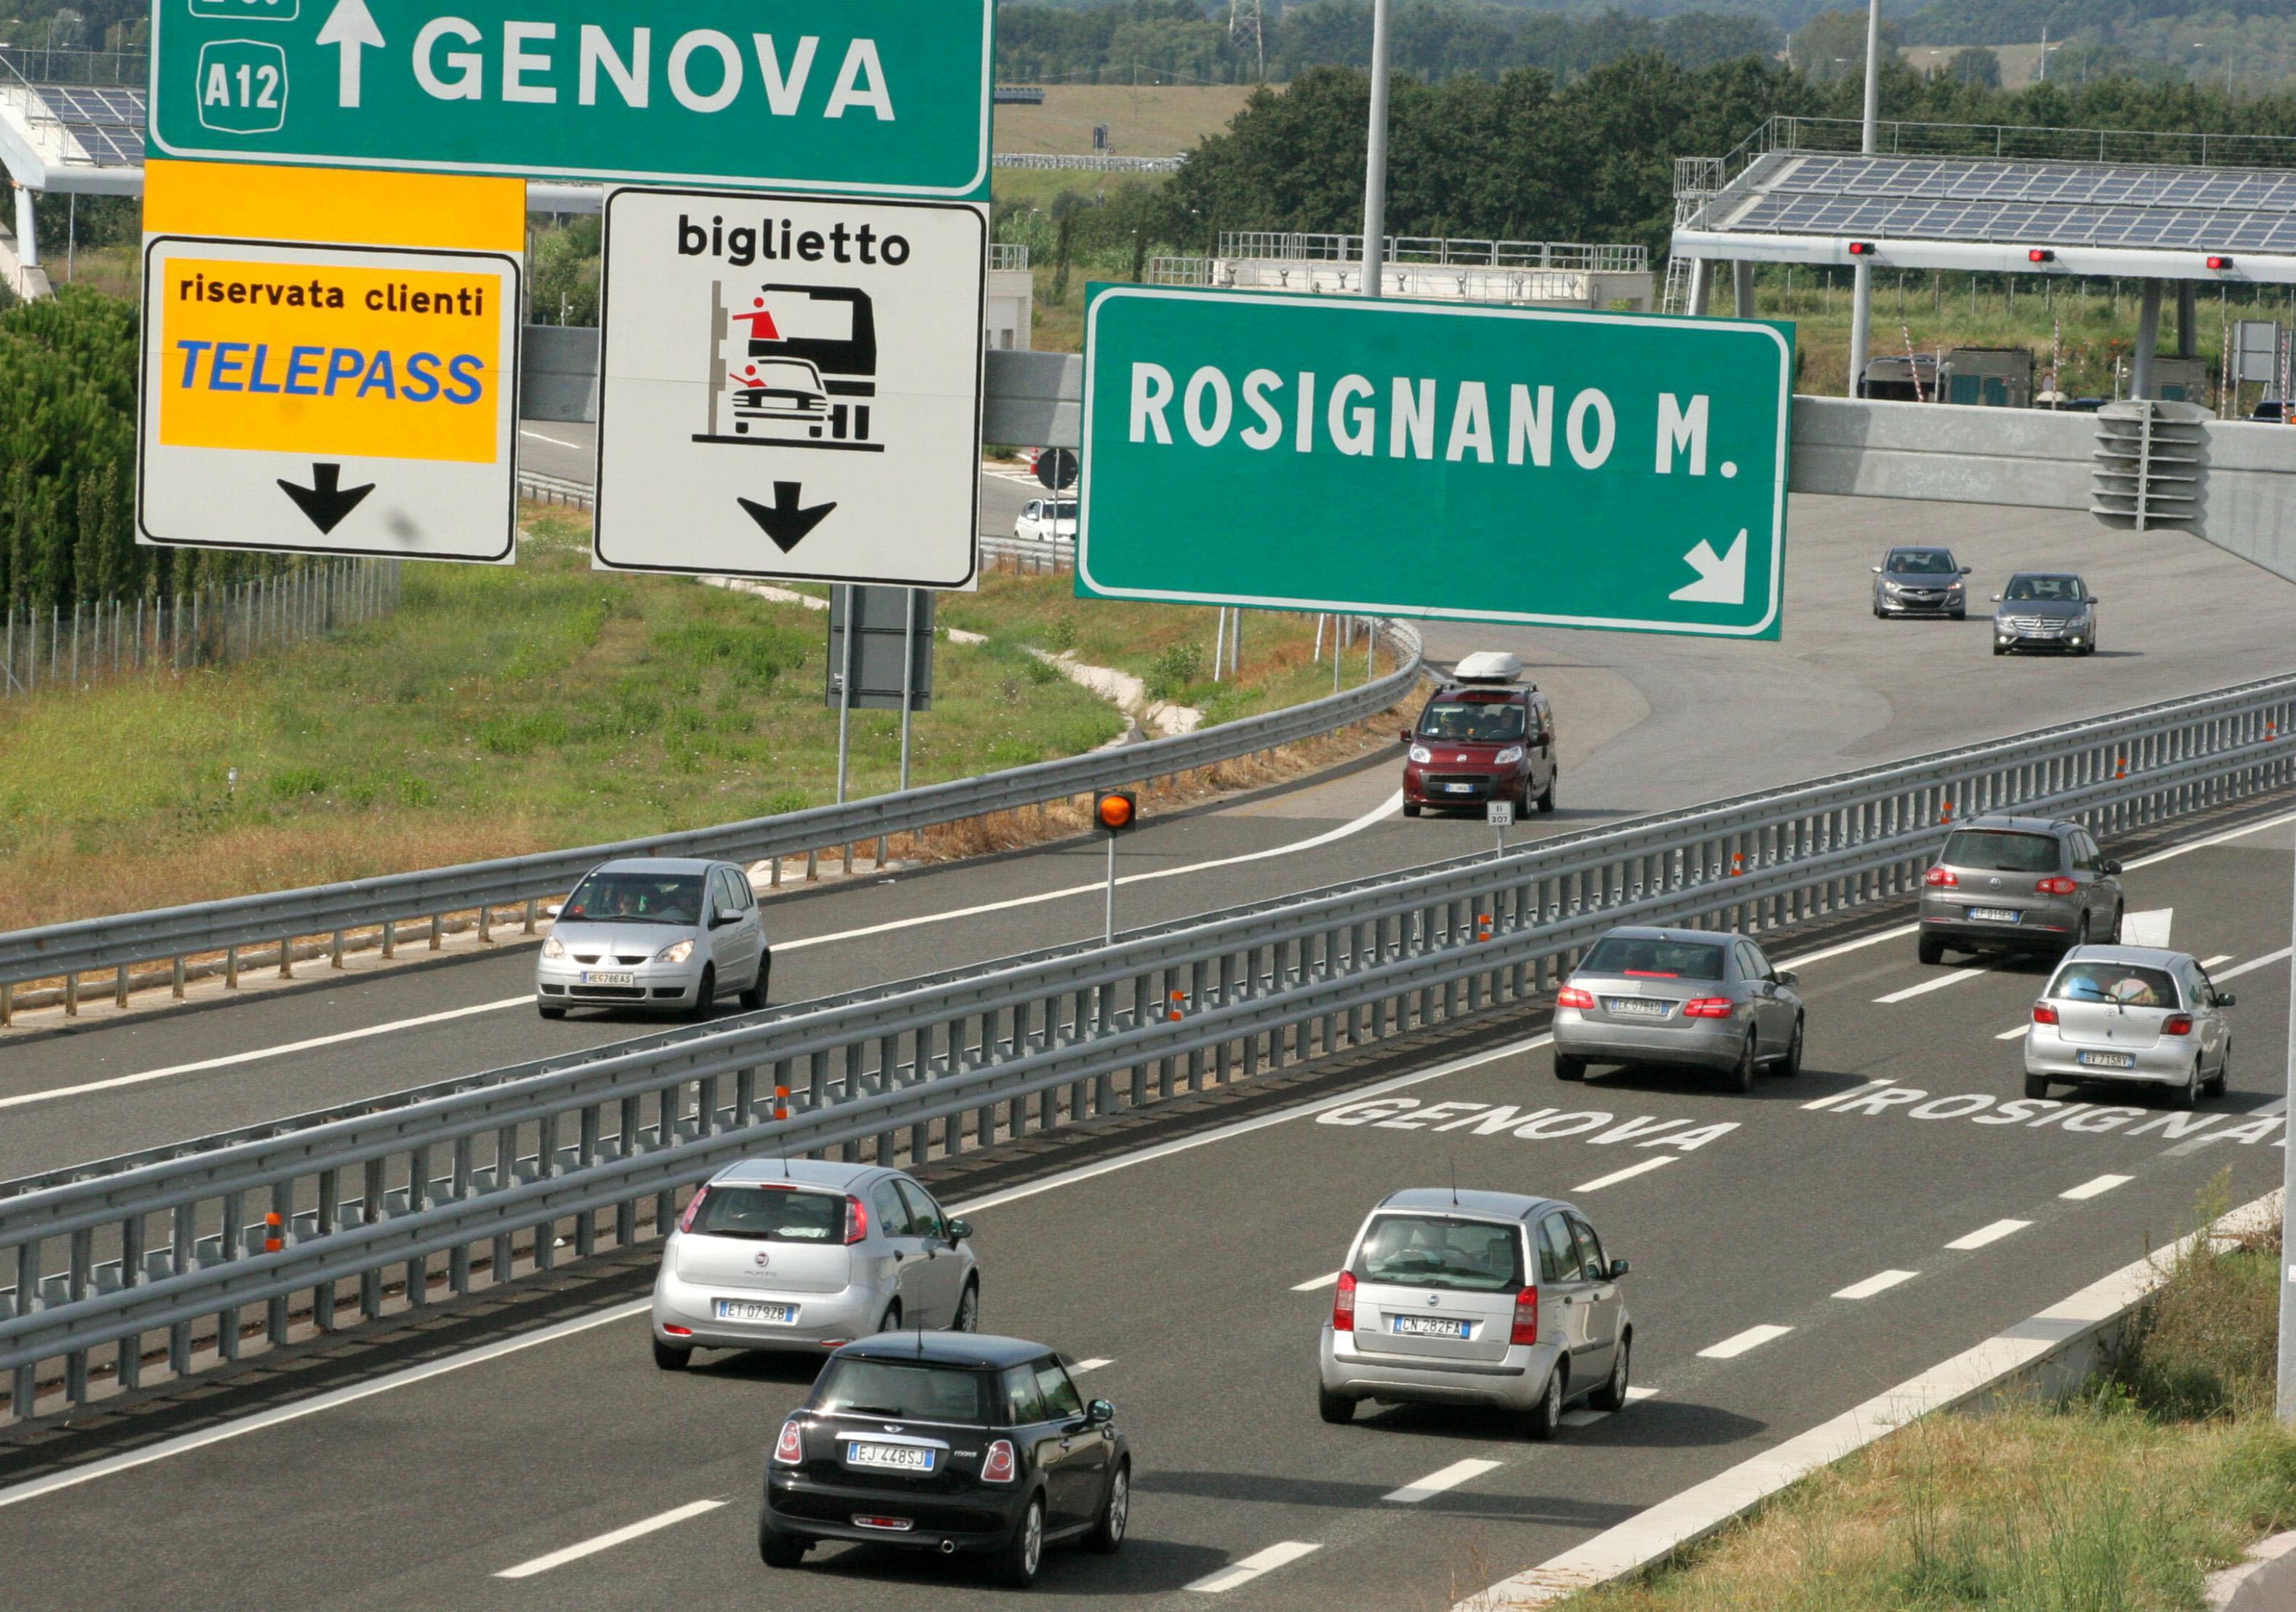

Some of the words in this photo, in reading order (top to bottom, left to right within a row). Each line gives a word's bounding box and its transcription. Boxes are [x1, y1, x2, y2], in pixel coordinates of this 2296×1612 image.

[205, 63, 279, 108] A12
[412, 16, 895, 121] GENOVA
[678, 215, 910, 266] biglietto
[180, 273, 345, 309] riservata
[365, 283, 483, 316] clienti
[177, 340, 484, 405] TELEPASS
[1129, 362, 1616, 470] ROSIGNANO
[1655, 392, 1738, 478] M.
[1315, 1098, 1742, 1150] GENOVA
[1827, 1088, 2287, 1147] ROSIGNA
[728, 1303, 741, 1316] ET
[1402, 1317, 1418, 1331] CN
[859, 1445, 874, 1461] EJ
[881, 1447, 924, 1465] 448SJ
